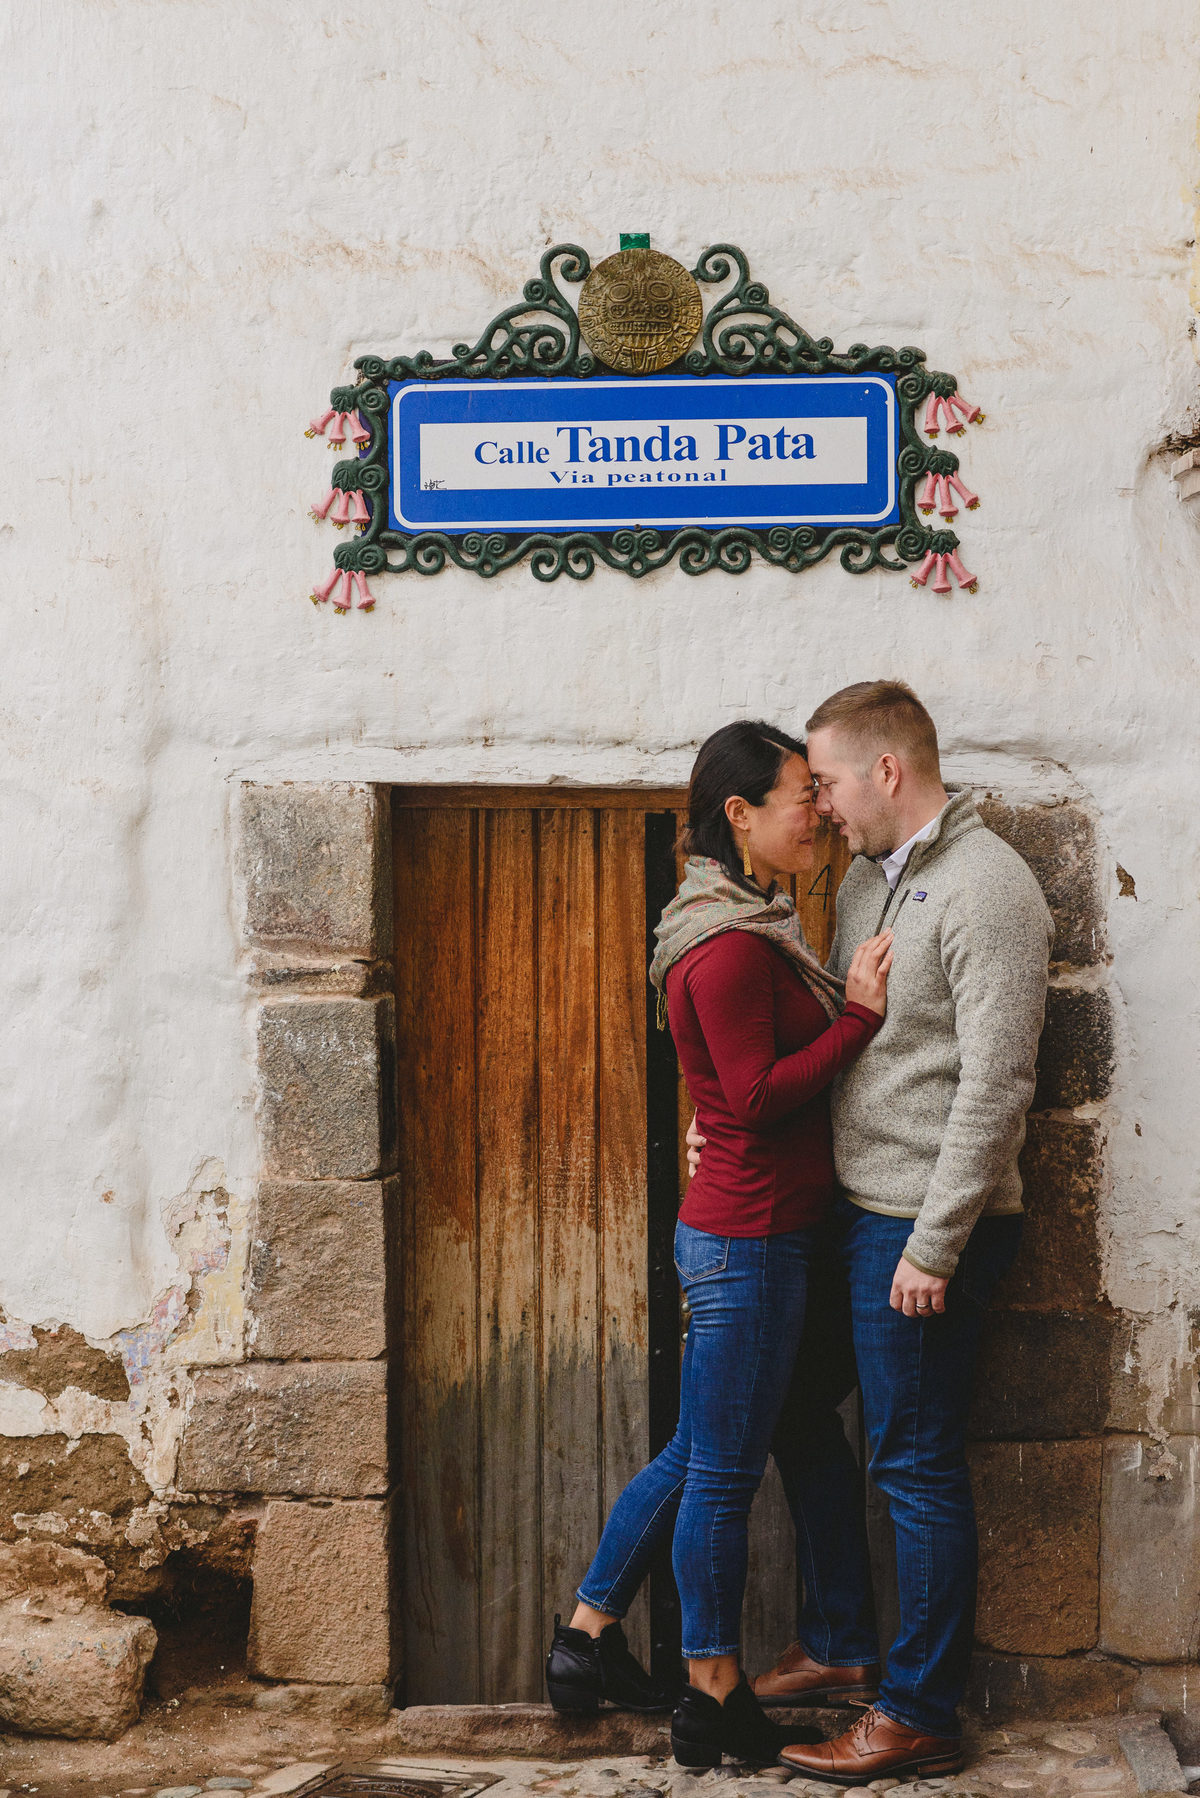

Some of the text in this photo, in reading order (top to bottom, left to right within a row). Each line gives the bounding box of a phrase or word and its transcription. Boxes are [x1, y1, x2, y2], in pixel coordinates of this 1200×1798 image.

[474, 424, 817, 464] Calle Tanda Pata
[549, 468, 727, 486] Via peatonal
[808, 863, 831, 912] 4
